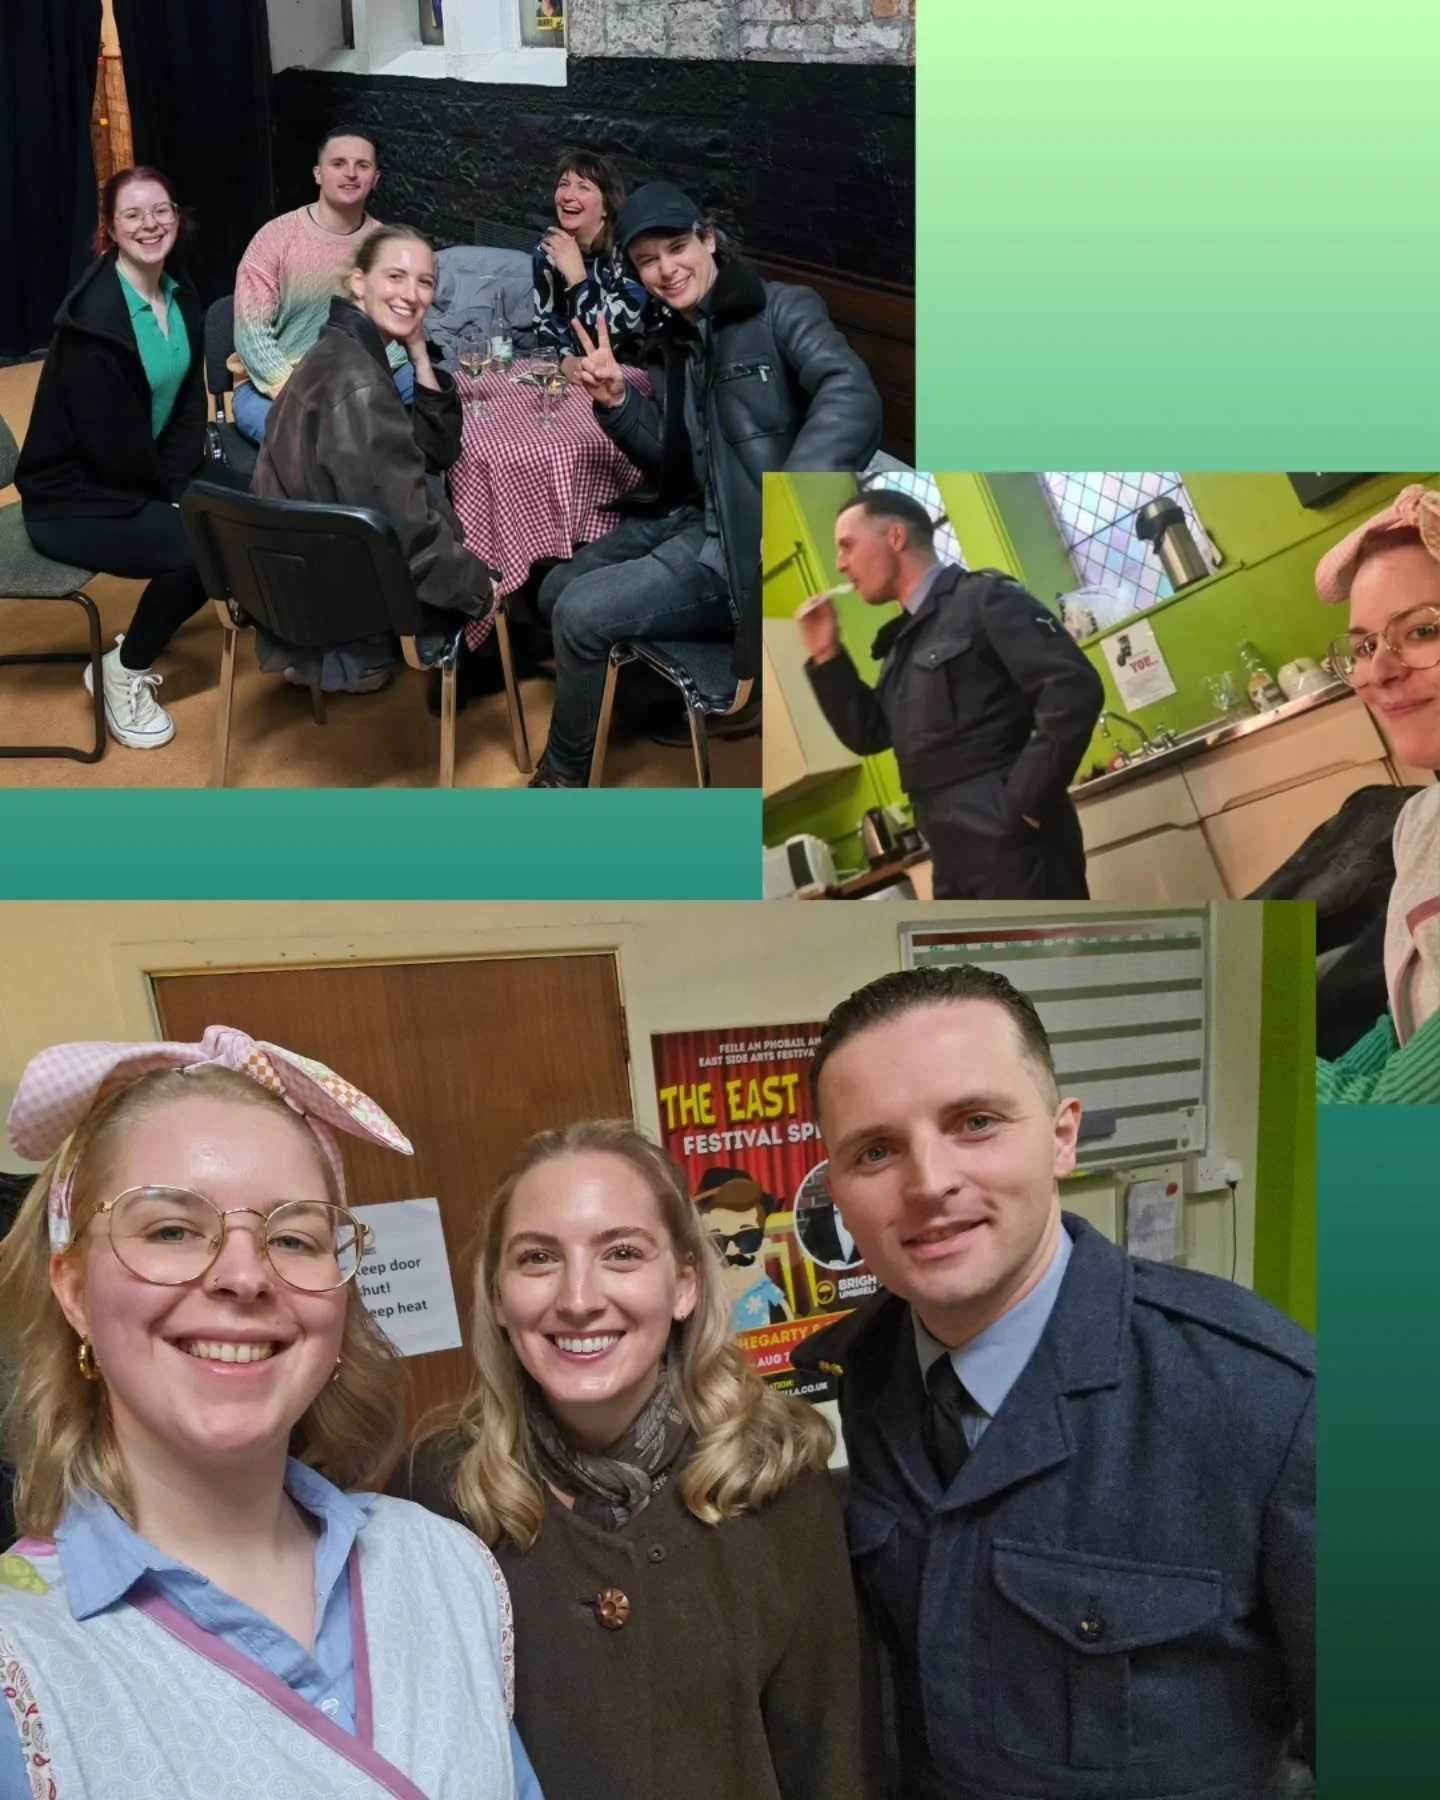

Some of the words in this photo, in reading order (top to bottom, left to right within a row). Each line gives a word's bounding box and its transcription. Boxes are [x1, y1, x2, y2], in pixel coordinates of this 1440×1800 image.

[719, 1042, 745, 1054] FEILE
[807, 1036, 822, 1047] AN
[698, 1055, 723, 1068] EAST
[725, 1053, 748, 1065] SIDE
[750, 1051, 775, 1063] ARTS
[776, 1048, 815, 1060] FESTIVA
[660, 1083, 716, 1130] THE
[725, 1072, 799, 1122] EAST
[683, 1126, 783, 1156] FESTIVAL
[390, 1258, 421, 1272] door
[360, 1281, 391, 1297] hut!
[838, 1274, 877, 1291] BRIGH
[839, 1285, 877, 1299] UMBRELL
[368, 1306, 395, 1319] eep
[397, 1299, 428, 1315] heat
[737, 1325, 809, 1351] HEGARTY
[756, 1352, 783, 1368] AUG
